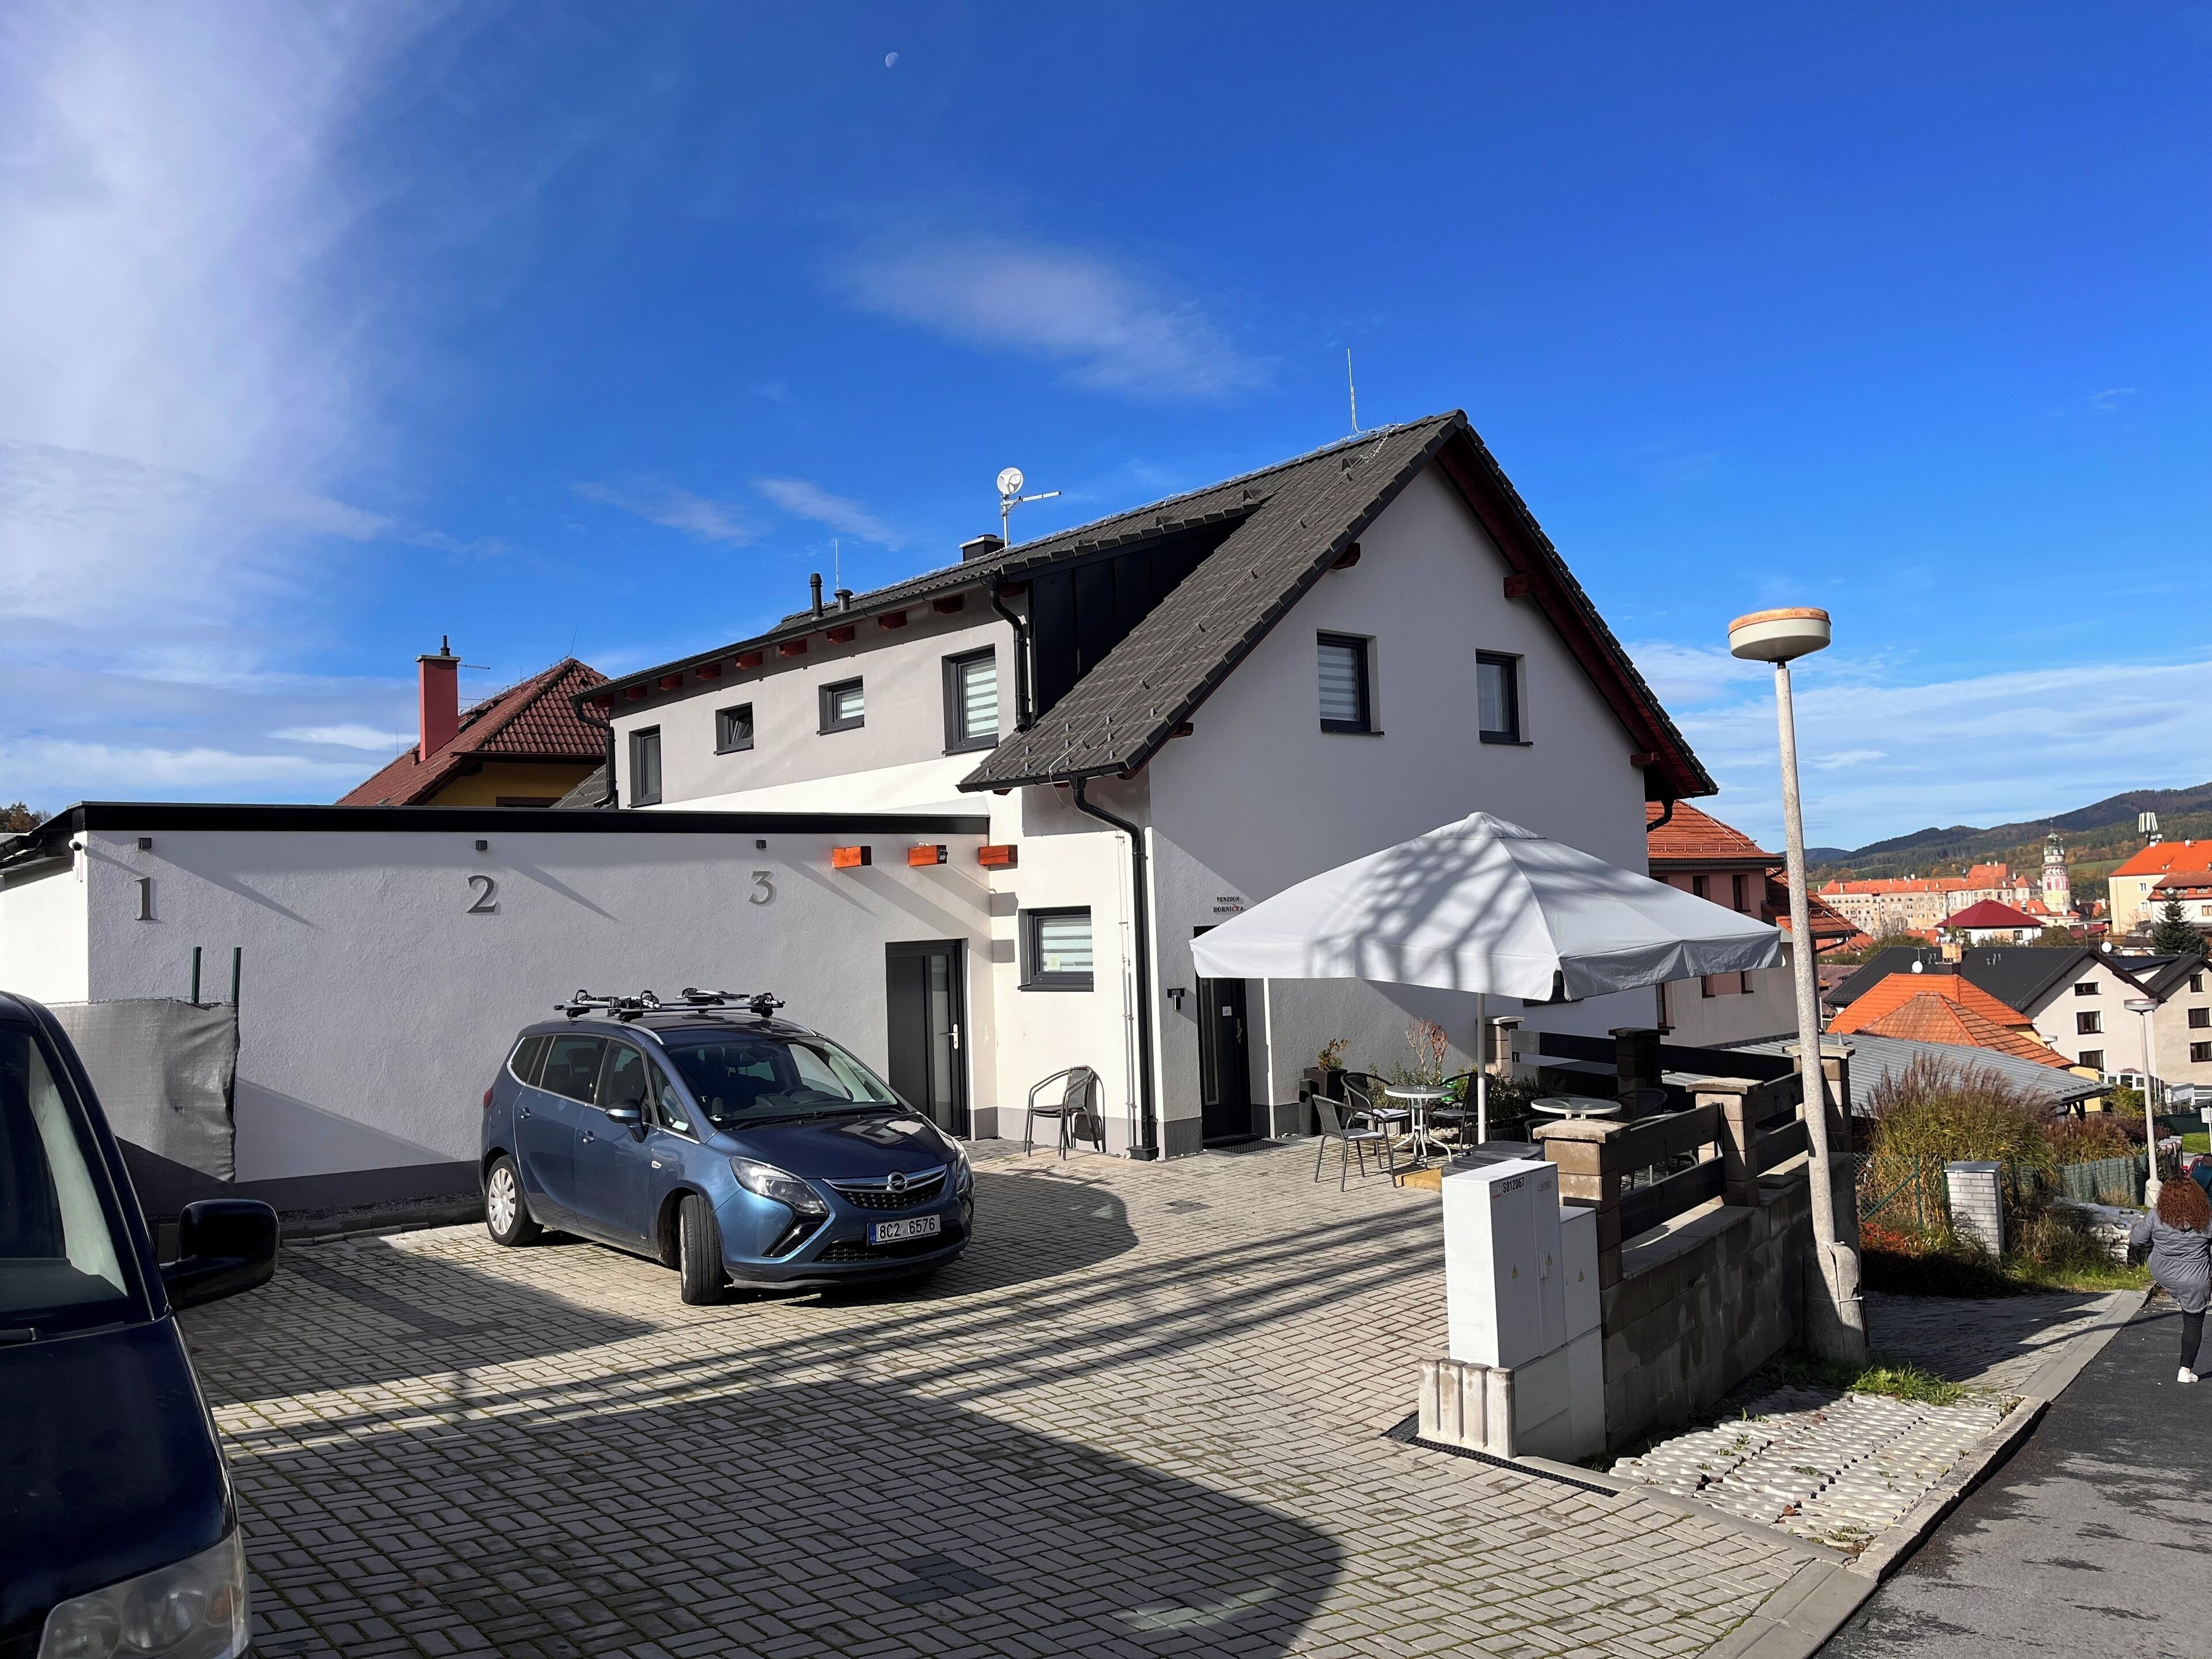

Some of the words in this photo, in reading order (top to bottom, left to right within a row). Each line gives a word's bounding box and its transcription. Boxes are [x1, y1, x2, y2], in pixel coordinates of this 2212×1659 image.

[134, 877, 158, 921] 1
[467, 875, 497, 913] 2
[748, 871, 773, 904] 3
[1213, 904, 1244, 912] HORNIČKA
[879, 1223, 900, 1238] 8C2
[909, 1217, 935, 1234] 6576
